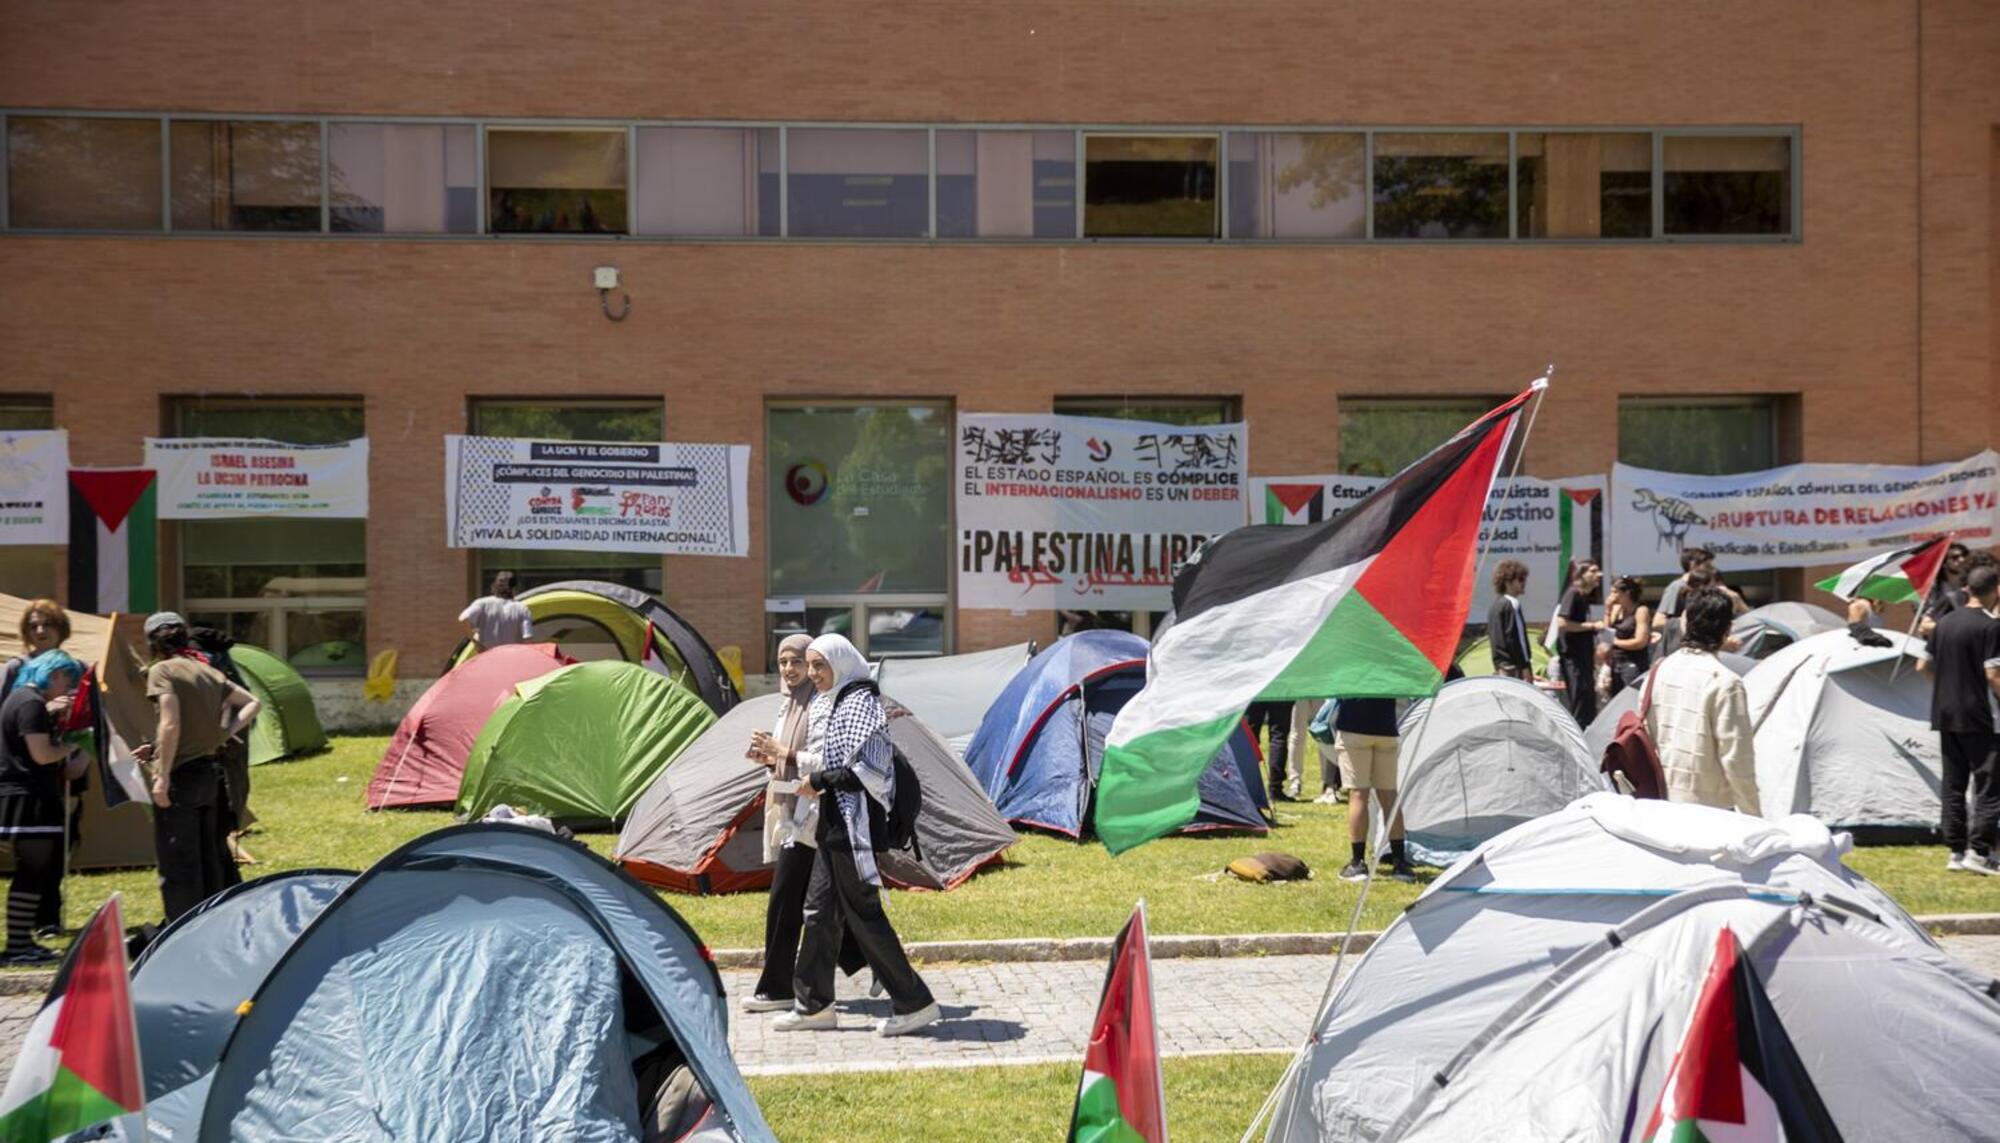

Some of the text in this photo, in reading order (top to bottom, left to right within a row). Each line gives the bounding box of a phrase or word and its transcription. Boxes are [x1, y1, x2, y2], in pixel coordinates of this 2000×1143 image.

[542, 446, 648, 457] LA UCM Y EL GOBIERNO
[210, 454, 296, 469] ISRAEL ASESINA
[553, 467, 570, 478] DEL
[571, 467, 625, 478] GENOCIDIO
[627, 469, 639, 479] EN
[965, 466, 1239, 485] EL ESTADO ESPAÑOL ES CÓMPLICE
[965, 483, 1239, 501] EL INTERNACIONALISMO ES UN DEBER
[1746, 484, 1794, 498] ESPAÑOL
[1797, 482, 1856, 495] CÓMPLICE
[1859, 484, 1881, 494] DEL
[1710, 508, 1808, 529] ¡RUPTURA
[1814, 508, 1841, 525] DE
[1844, 496, 1969, 525] RELACIONES
[471, 528, 717, 544] ¡VIVA LA SOLIDARIDAD INTERNACIONAL!
